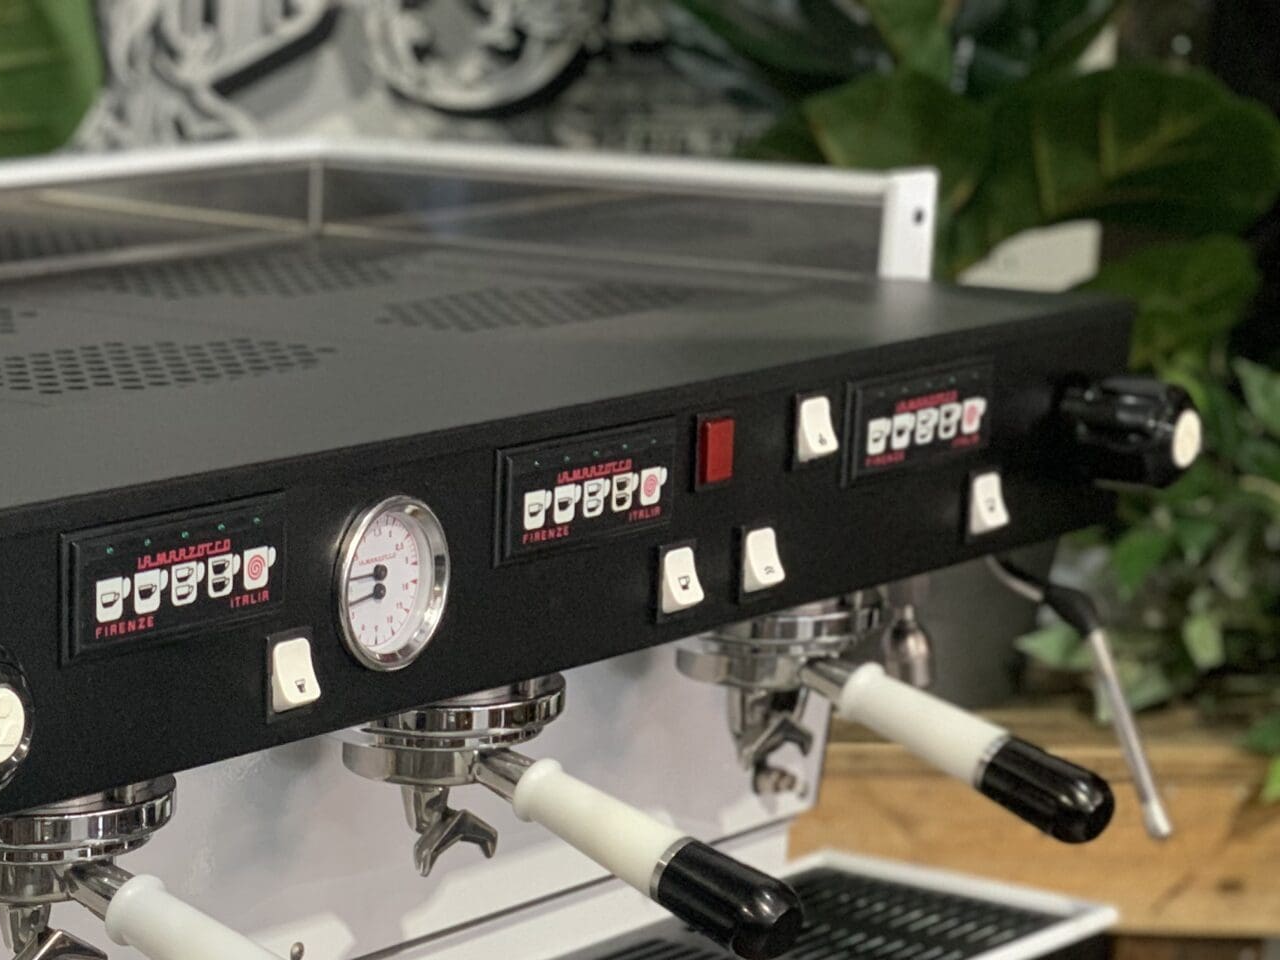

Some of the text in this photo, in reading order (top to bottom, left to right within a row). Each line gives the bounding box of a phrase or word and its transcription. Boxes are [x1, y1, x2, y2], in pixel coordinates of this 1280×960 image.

[628, 506, 661, 521] ITALIA
[522, 525, 570, 544] FIRENZE
[230, 590, 270, 609] ITALIA
[96, 616, 155, 639] FIRENZE
